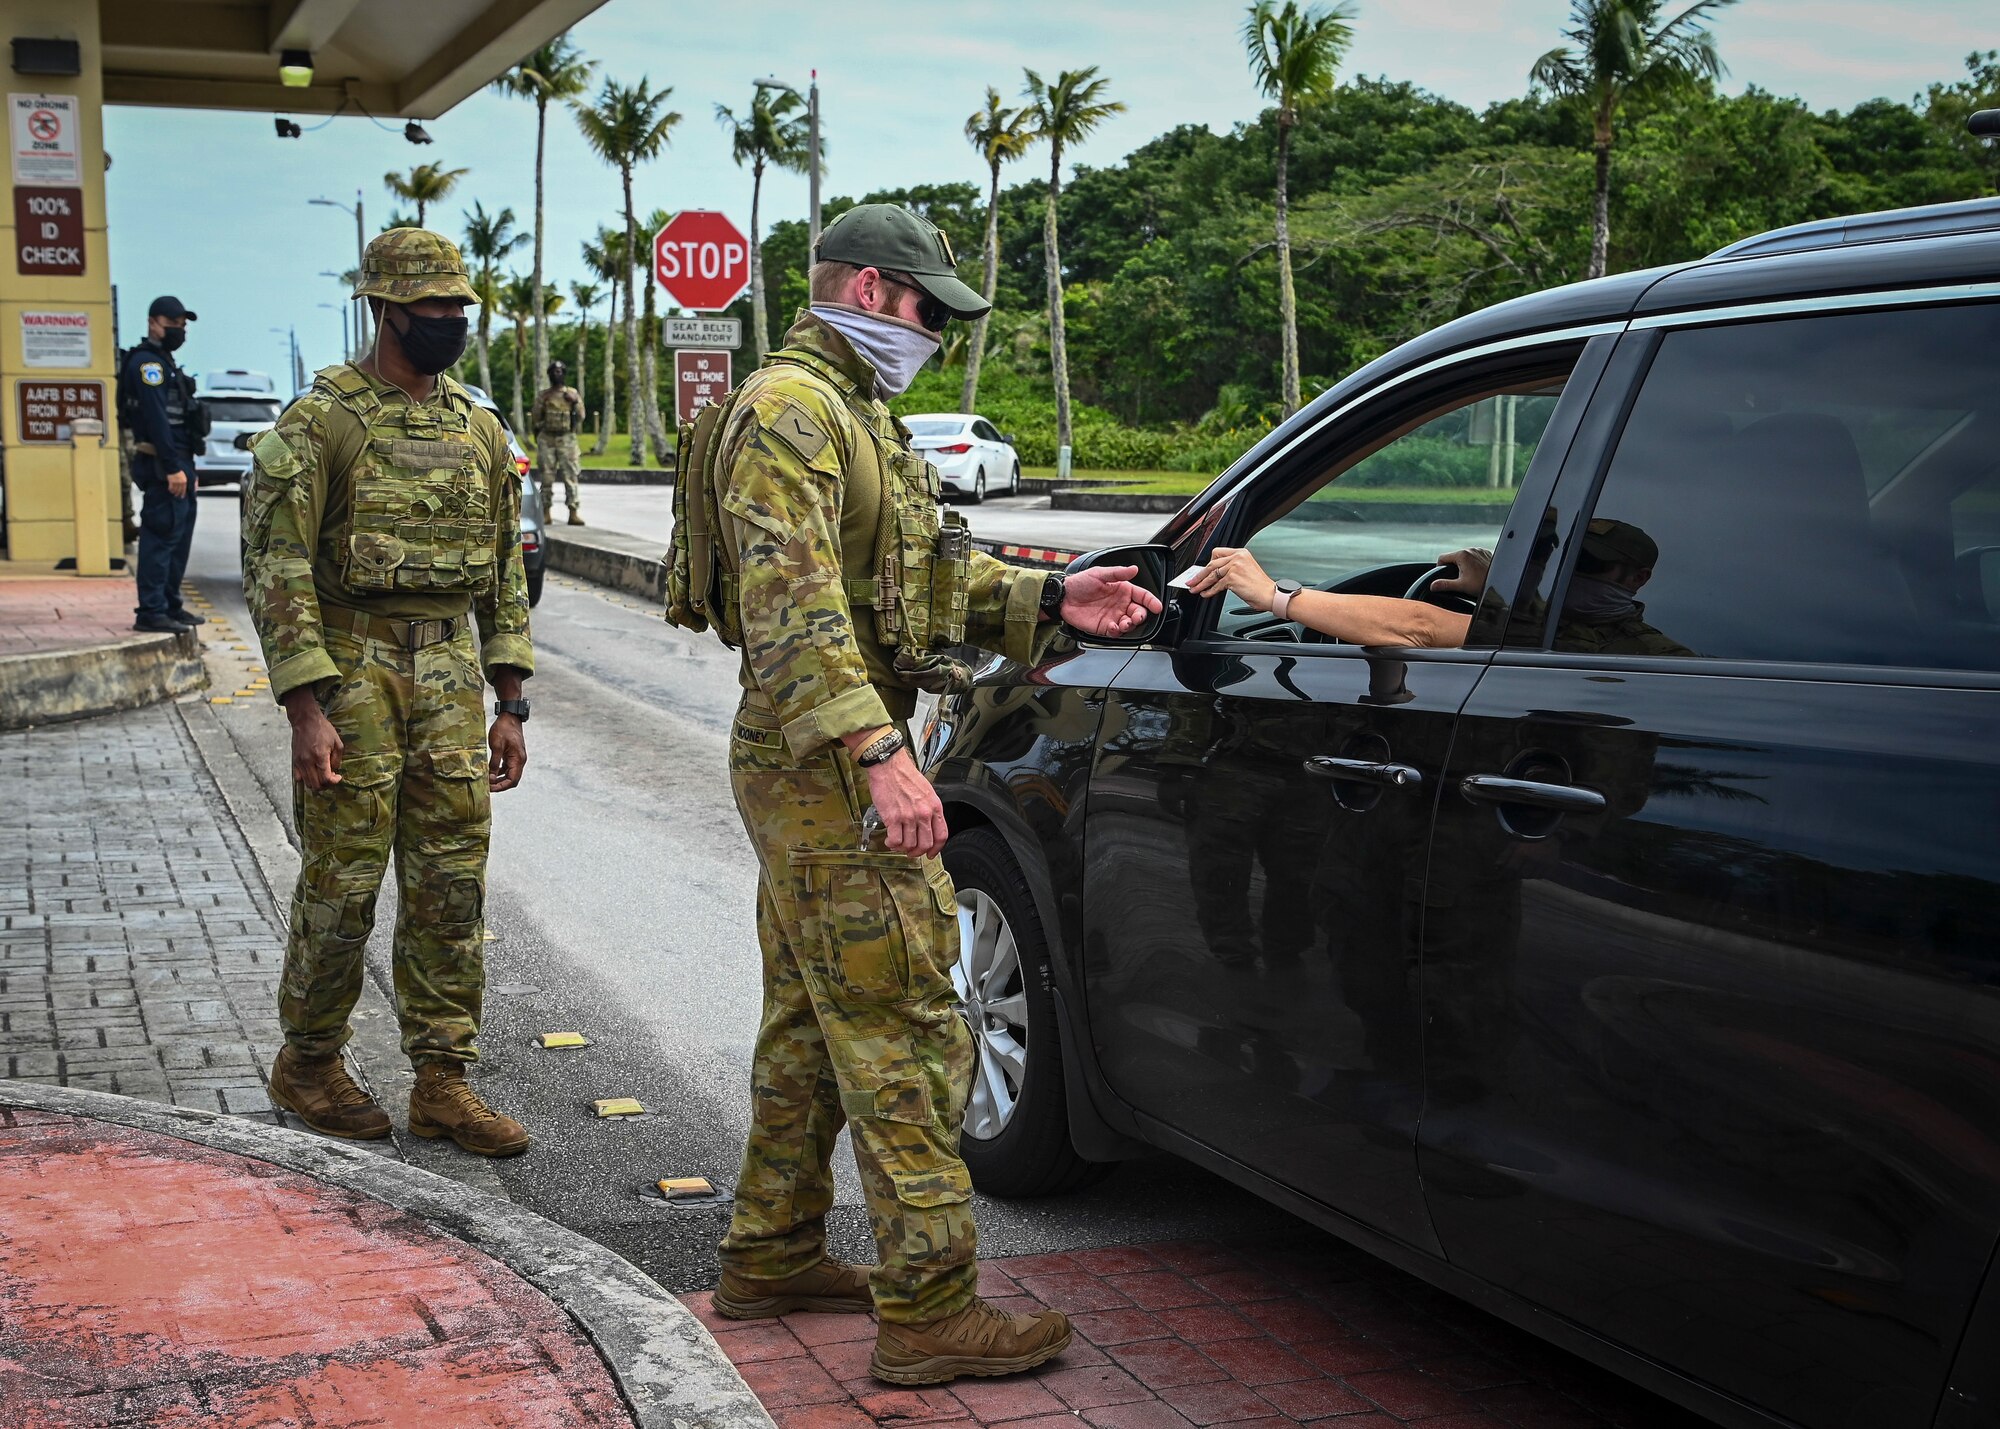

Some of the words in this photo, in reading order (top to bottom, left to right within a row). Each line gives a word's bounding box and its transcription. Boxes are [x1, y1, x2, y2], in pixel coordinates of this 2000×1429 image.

[17, 100, 32, 109] NO
[34, 100, 70, 110] DRONE
[32, 141, 59, 150] ZONE
[27, 197, 70, 215] 100%
[41, 222, 59, 240] ID
[21, 246, 80, 265] CHECK
[660, 241, 744, 279] STOP
[24, 315, 88, 327] WARNING
[673, 323, 697, 331] SEAT
[703, 324, 733, 333] BELTS
[672, 333, 733, 342] MANDATORY
[697, 359, 709, 370] NO
[682, 371, 700, 382] CELL
[701, 371, 725, 382] PHONE
[26, 387, 60, 402] AAFB
[63, 387, 77, 402] IS
[696, 384, 711, 394] USE
[27, 404, 59, 418] FPCON
